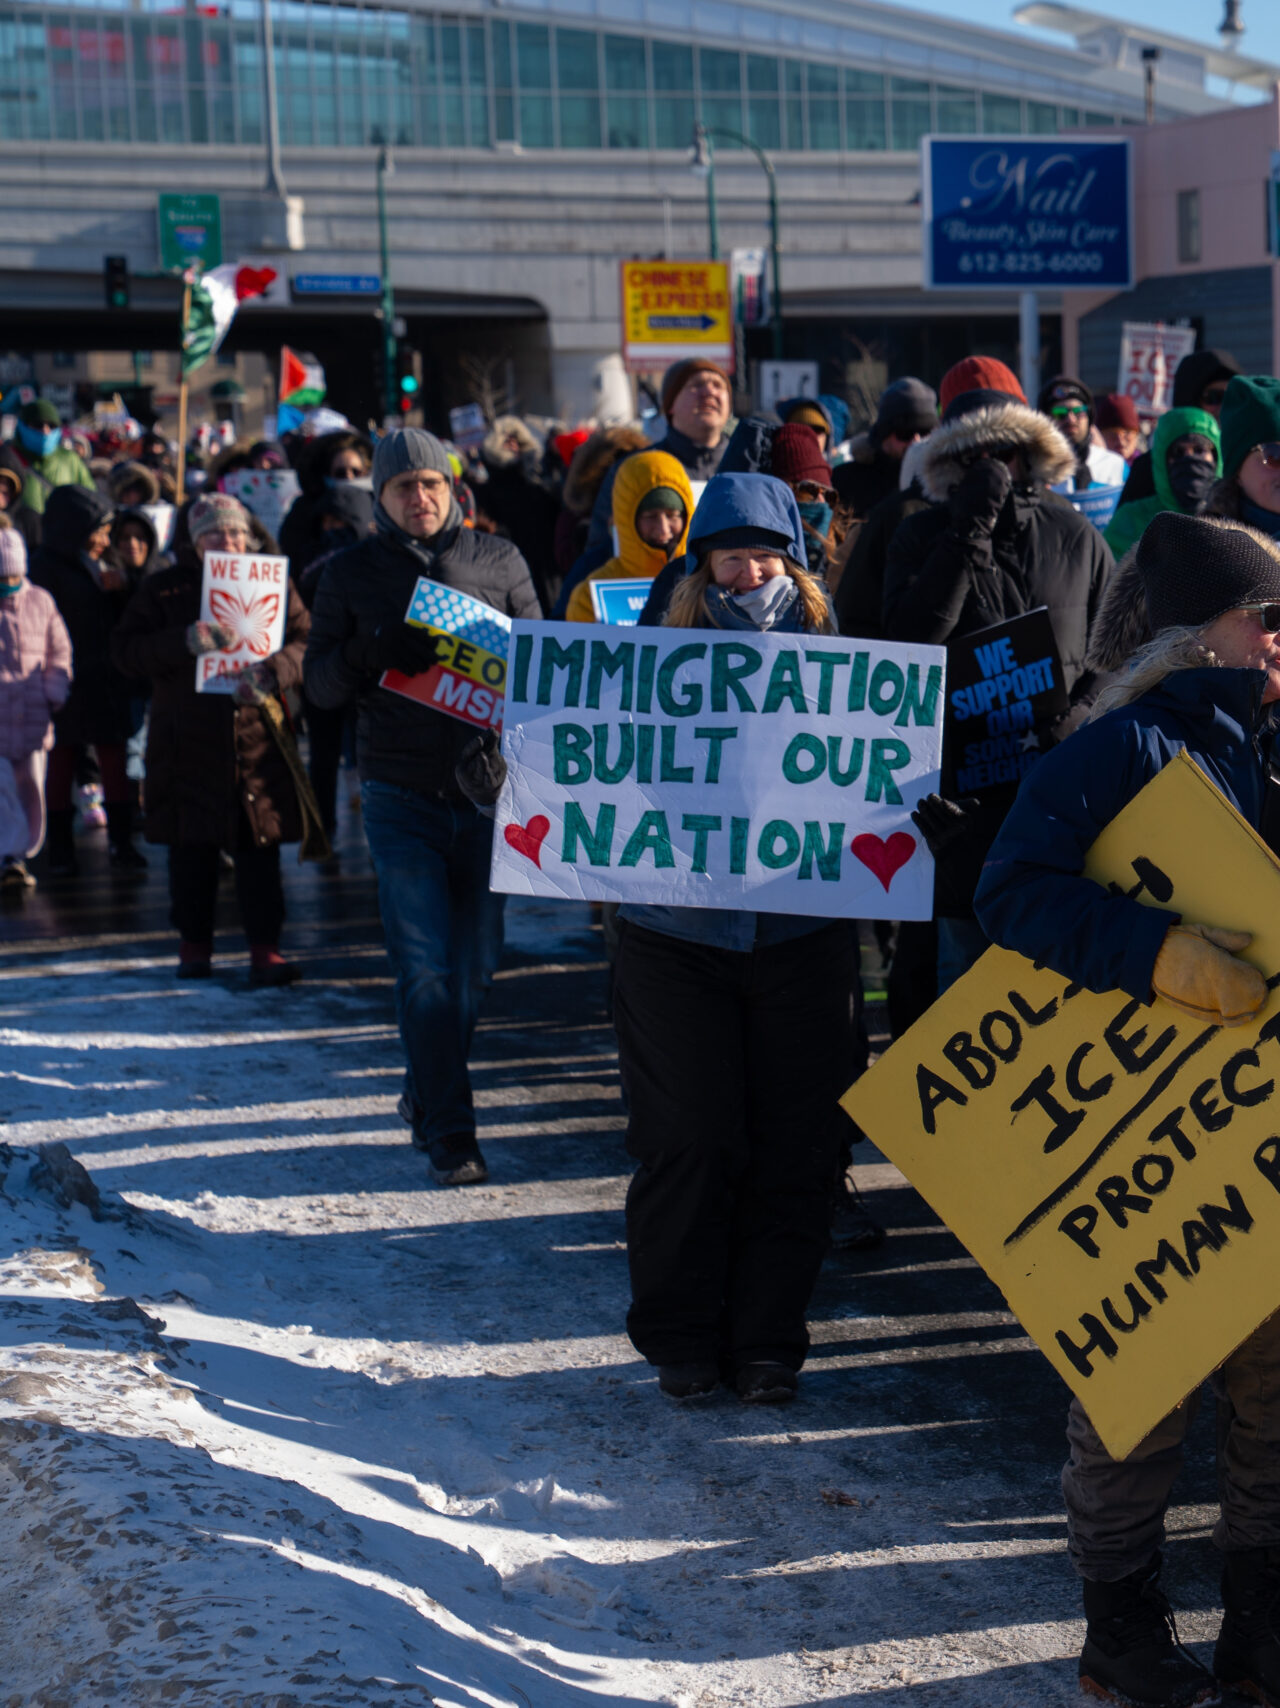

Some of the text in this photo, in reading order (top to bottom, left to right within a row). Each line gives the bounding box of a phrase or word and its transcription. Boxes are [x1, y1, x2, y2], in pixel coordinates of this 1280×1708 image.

[957, 149, 1097, 215] Nail
[1071, 220, 1119, 249] Care
[1128, 350, 1177, 379] ICE
[210, 559, 283, 583] WE ARE
[627, 596, 649, 611] W
[433, 634, 477, 674] CE
[973, 636, 1018, 678] WE
[511, 633, 942, 727] IMMIGRATION
[951, 656, 1055, 721] SUPPORT
[986, 699, 1035, 737] OUR
[553, 722, 912, 805] BUILT OUR
[956, 751, 1042, 793] NEIGH
[561, 801, 846, 882] NATION
[1011, 1000, 1178, 1153] ICE
[1055, 1184, 1255, 1378] HUMAN
